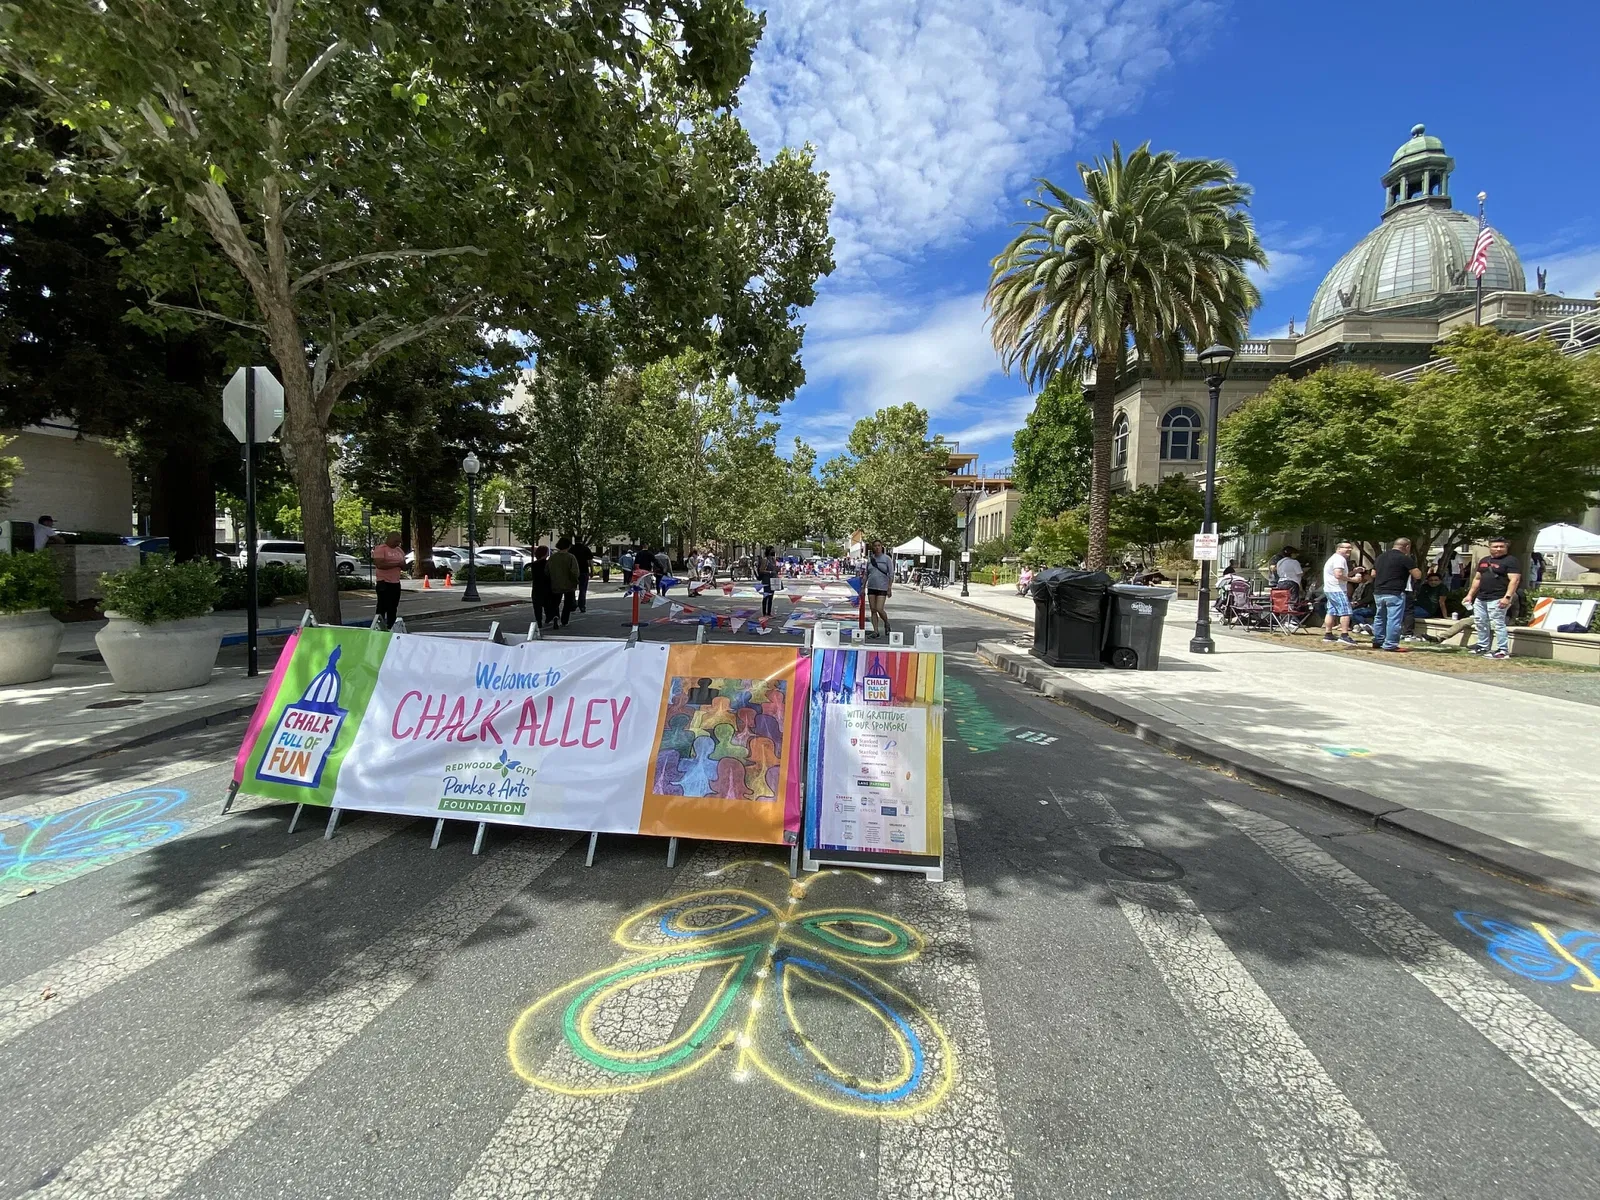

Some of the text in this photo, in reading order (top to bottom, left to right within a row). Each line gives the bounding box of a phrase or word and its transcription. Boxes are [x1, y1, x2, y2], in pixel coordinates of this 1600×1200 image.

[475, 661, 561, 691] Welcome to
[868, 691, 887, 699] FUN
[284, 711, 333, 734] CHALK
[391, 690, 631, 751] CHALK ALLEY
[847, 710, 905, 721] WITH GRATITUDE
[844, 720, 907, 732] TO OUR SPONSORS!
[278, 731, 322, 750] FULL OF
[267, 747, 312, 777] FUN
[445, 761, 537, 777] REDWOOD CITY
[442, 775, 530, 798] Parks & Arts
[443, 801, 522, 813] FOUNDATION
